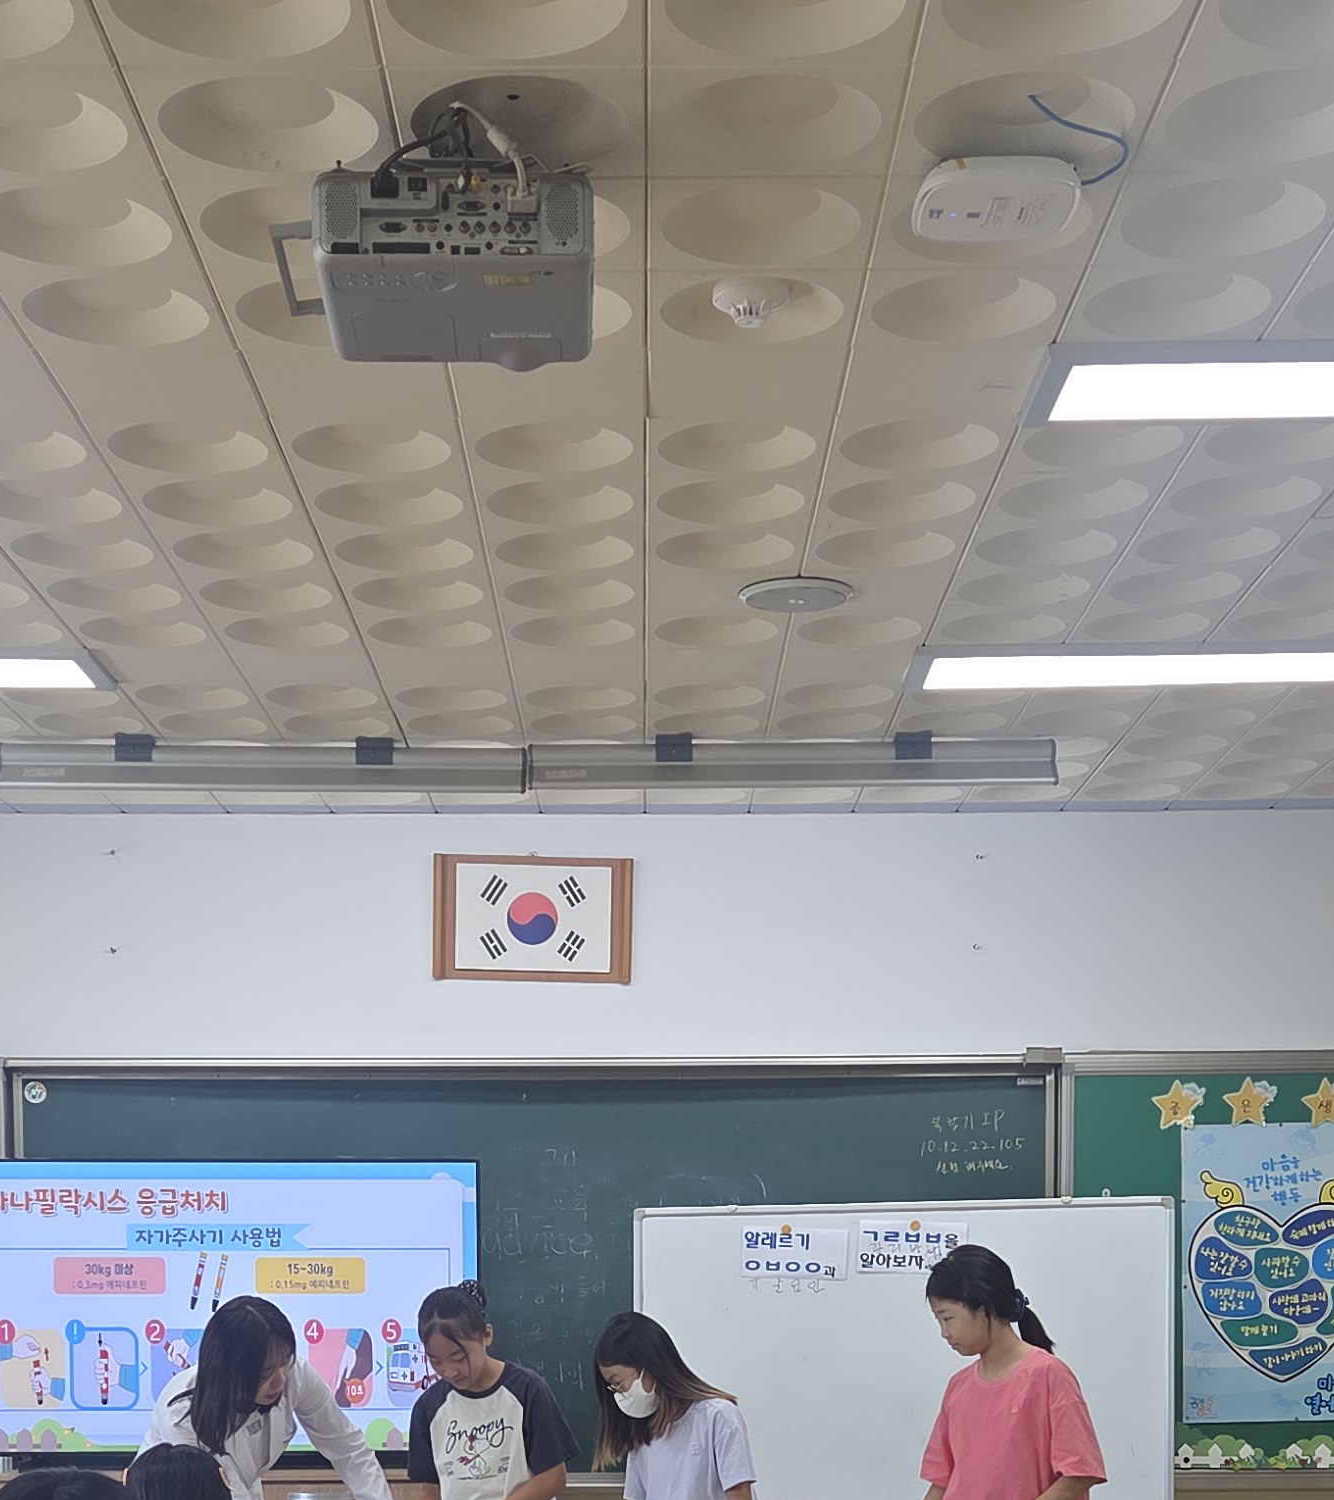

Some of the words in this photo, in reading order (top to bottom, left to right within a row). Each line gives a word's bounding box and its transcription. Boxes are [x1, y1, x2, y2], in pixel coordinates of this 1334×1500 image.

[982, 1109, 1004, 1131] IP
[1261, 1153, 1301, 1173] 마음을
[1243, 1173, 1299, 1193] 건강하게
[136, 1188, 229, 1216] 응급처치
[1271, 1187, 1303, 1207] 행동
[135, 1228, 223, 1247] 자가주사기
[230, 1227, 281, 1247] 사용법
[744, 1231, 810, 1250] 알레르기
[85, 1263, 111, 1278] 30kg
[287, 1263, 333, 1277] 15~30kg
[149, 1324, 161, 1340] 2
[305, 1321, 319, 1340] 4
[386, 1322, 397, 1340] 5
[445, 1417, 514, 1454] Snoopy
